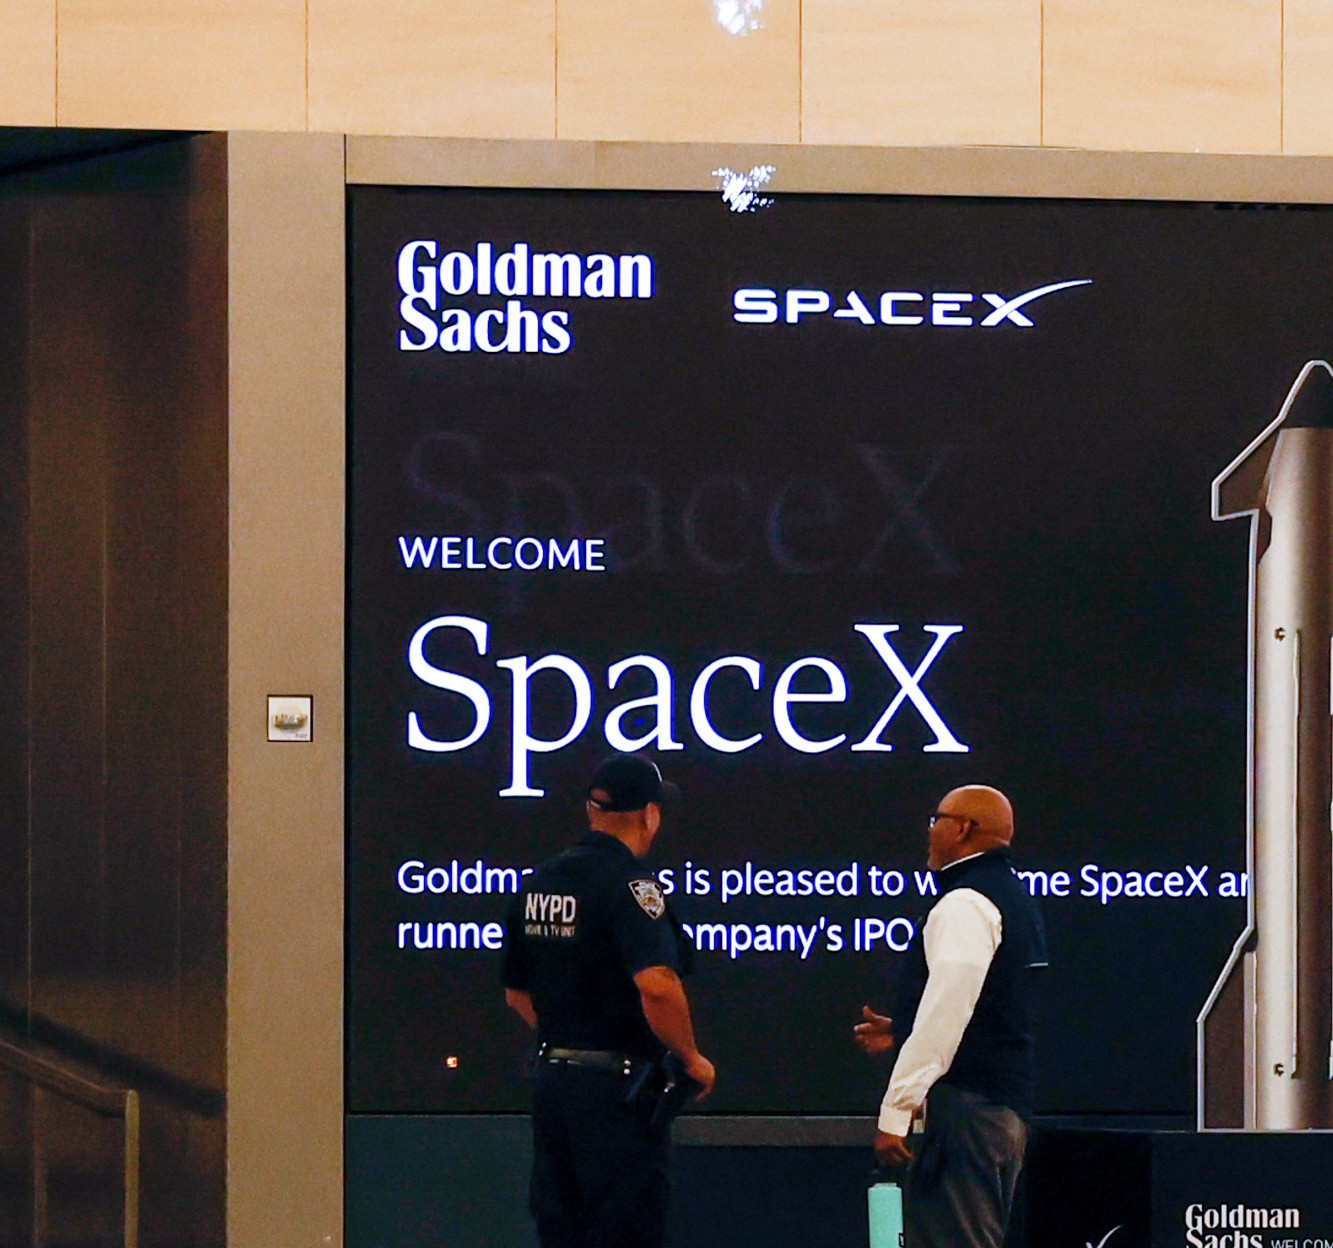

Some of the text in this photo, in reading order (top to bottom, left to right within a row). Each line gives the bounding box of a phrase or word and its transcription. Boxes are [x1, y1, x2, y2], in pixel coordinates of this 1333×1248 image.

[398, 240, 652, 305] Goldman
[399, 297, 571, 354] Sachs
[733, 279, 1093, 327] SPACEX
[398, 537, 606, 571] WELCOME
[406, 615, 969, 798] SpaceX
[397, 859, 534, 896] Goldm
[685, 861, 711, 895] is
[721, 861, 858, 904] pleased
[867, 865, 904, 896] to
[1080, 864, 1209, 905] SpaceX
[524, 892, 577, 923] NYPD
[398, 922, 504, 951] runne
[855, 917, 914, 952] IPO
[1185, 1204, 1300, 1232] Goldman
